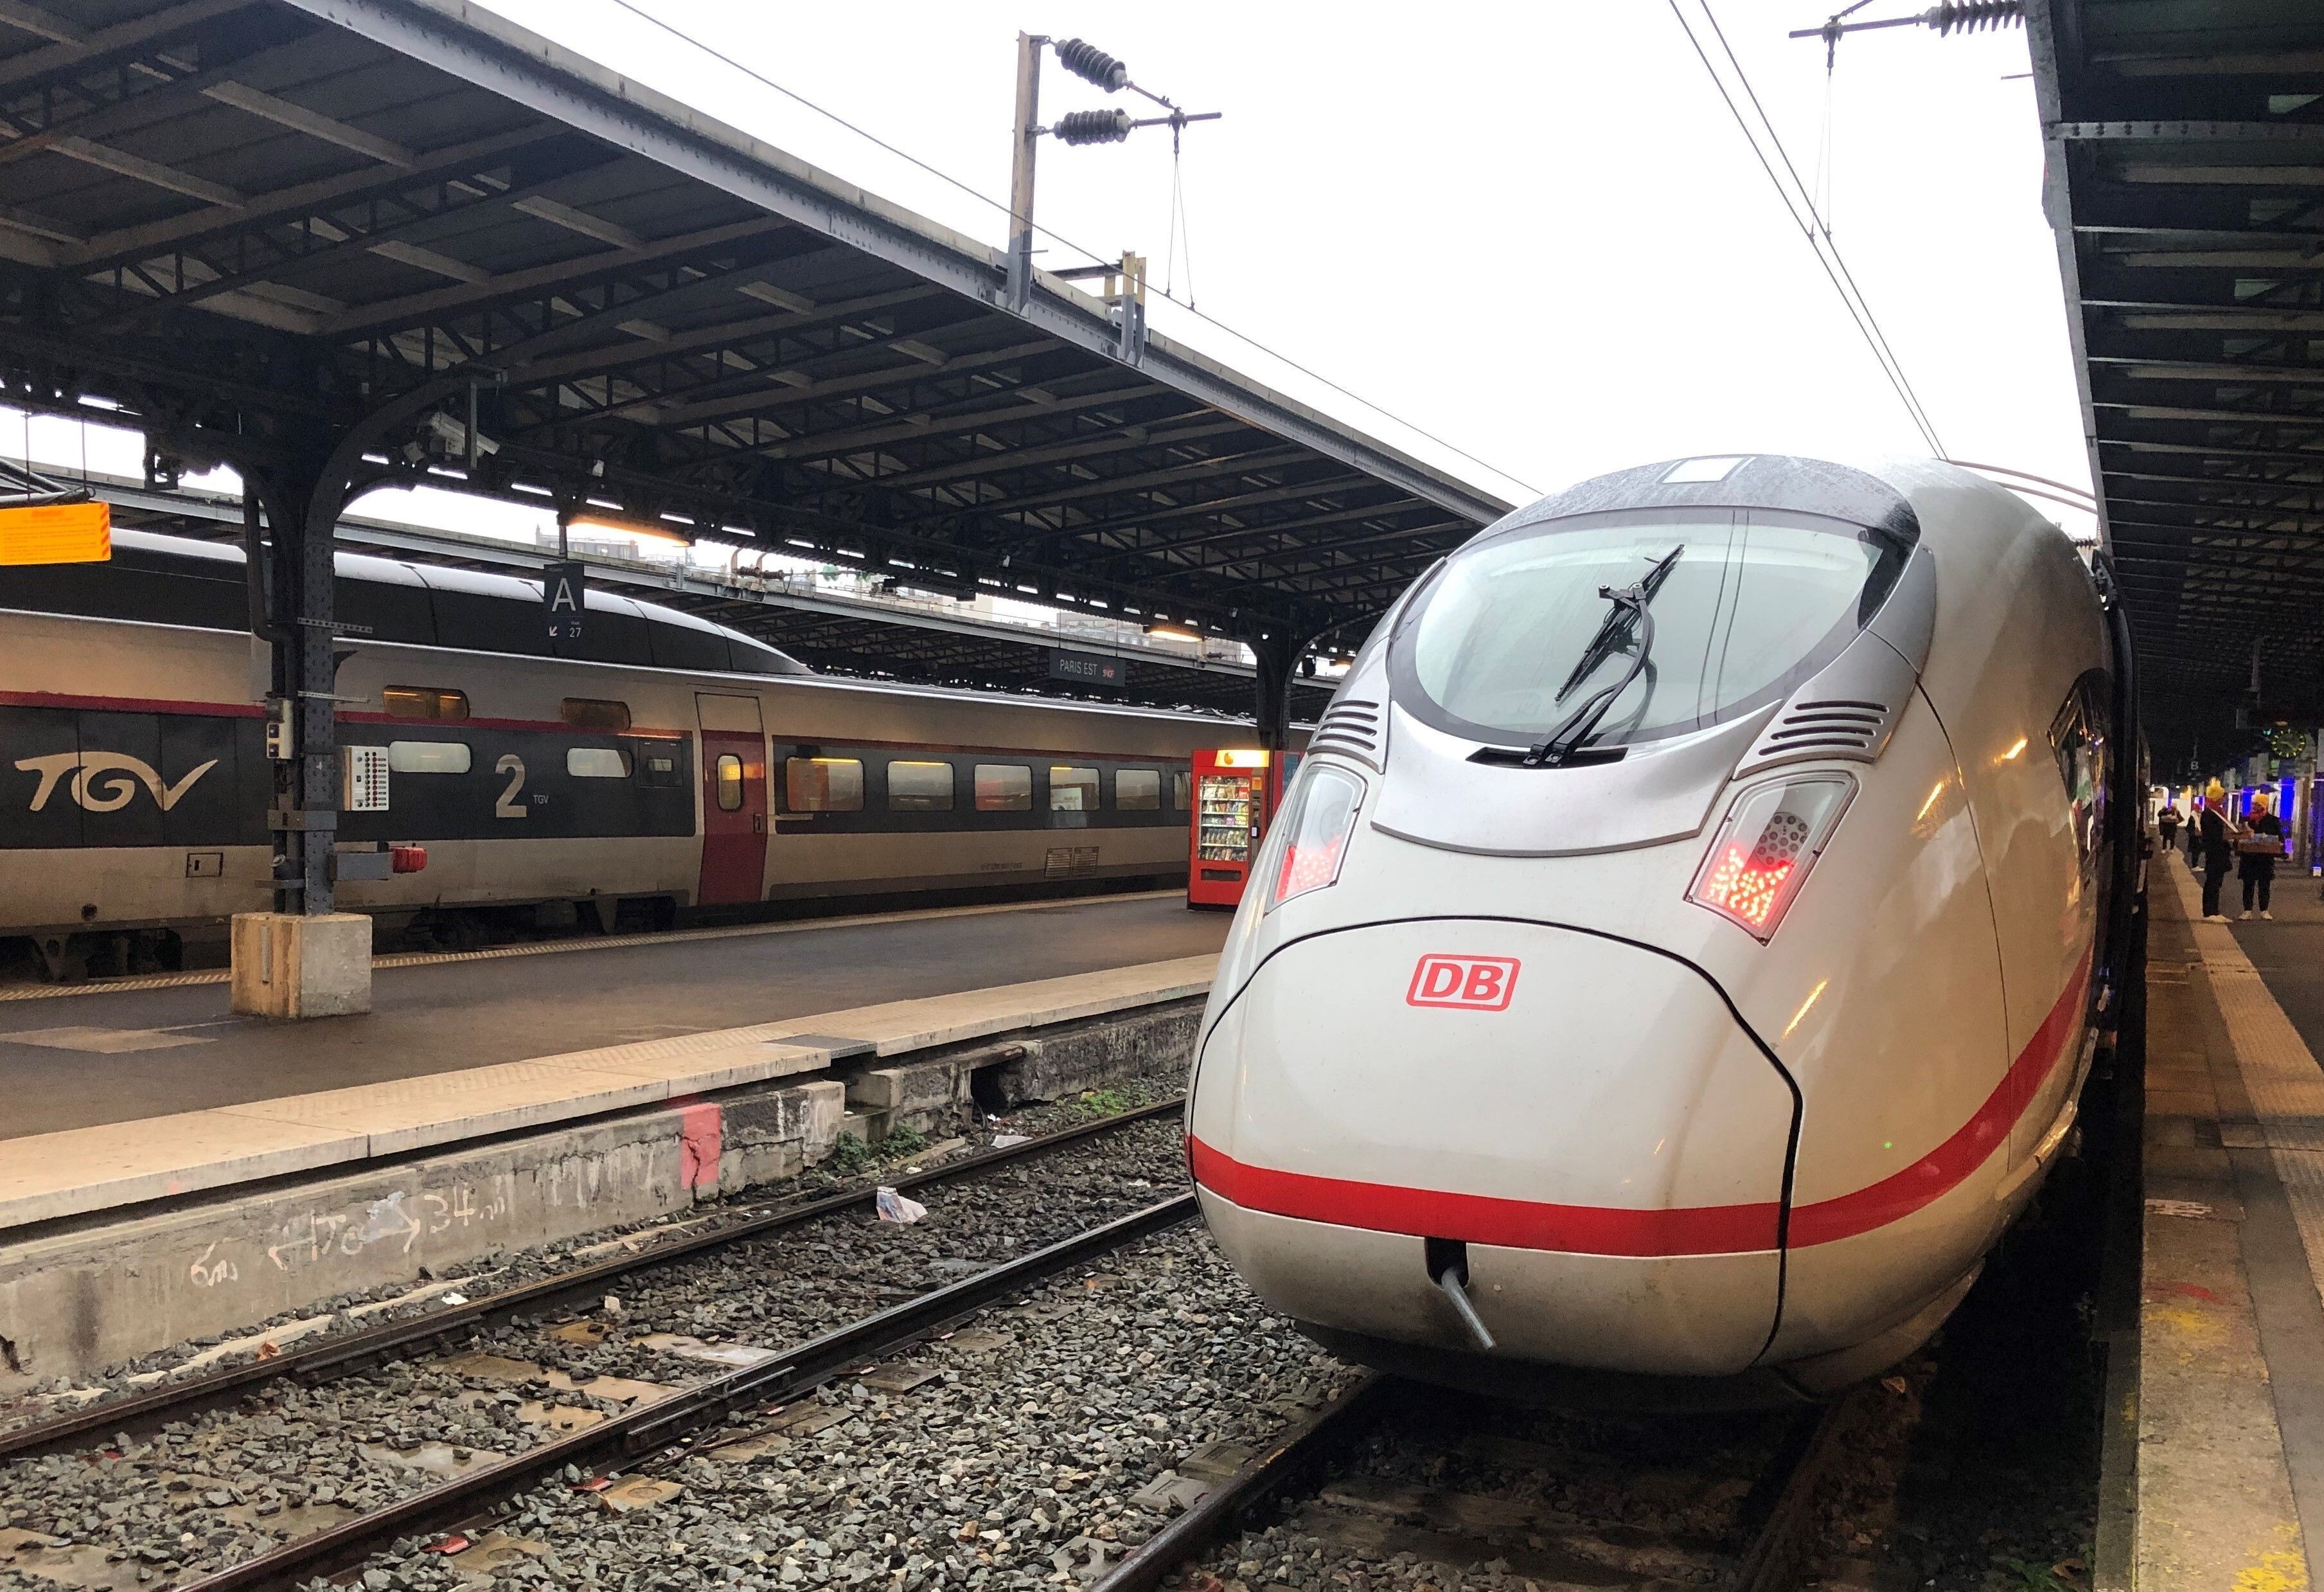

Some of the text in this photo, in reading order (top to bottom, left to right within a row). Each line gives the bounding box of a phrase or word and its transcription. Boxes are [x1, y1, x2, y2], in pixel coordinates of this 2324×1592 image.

[552, 578, 576, 612] A
[569, 627, 581, 638] 27
[1060, 659, 1097, 675] PARIS EST
[14, 751, 219, 812] TGV
[494, 754, 527, 818] 2
[533, 795, 549, 803] TGV
[1421, 962, 1504, 1001] DB
